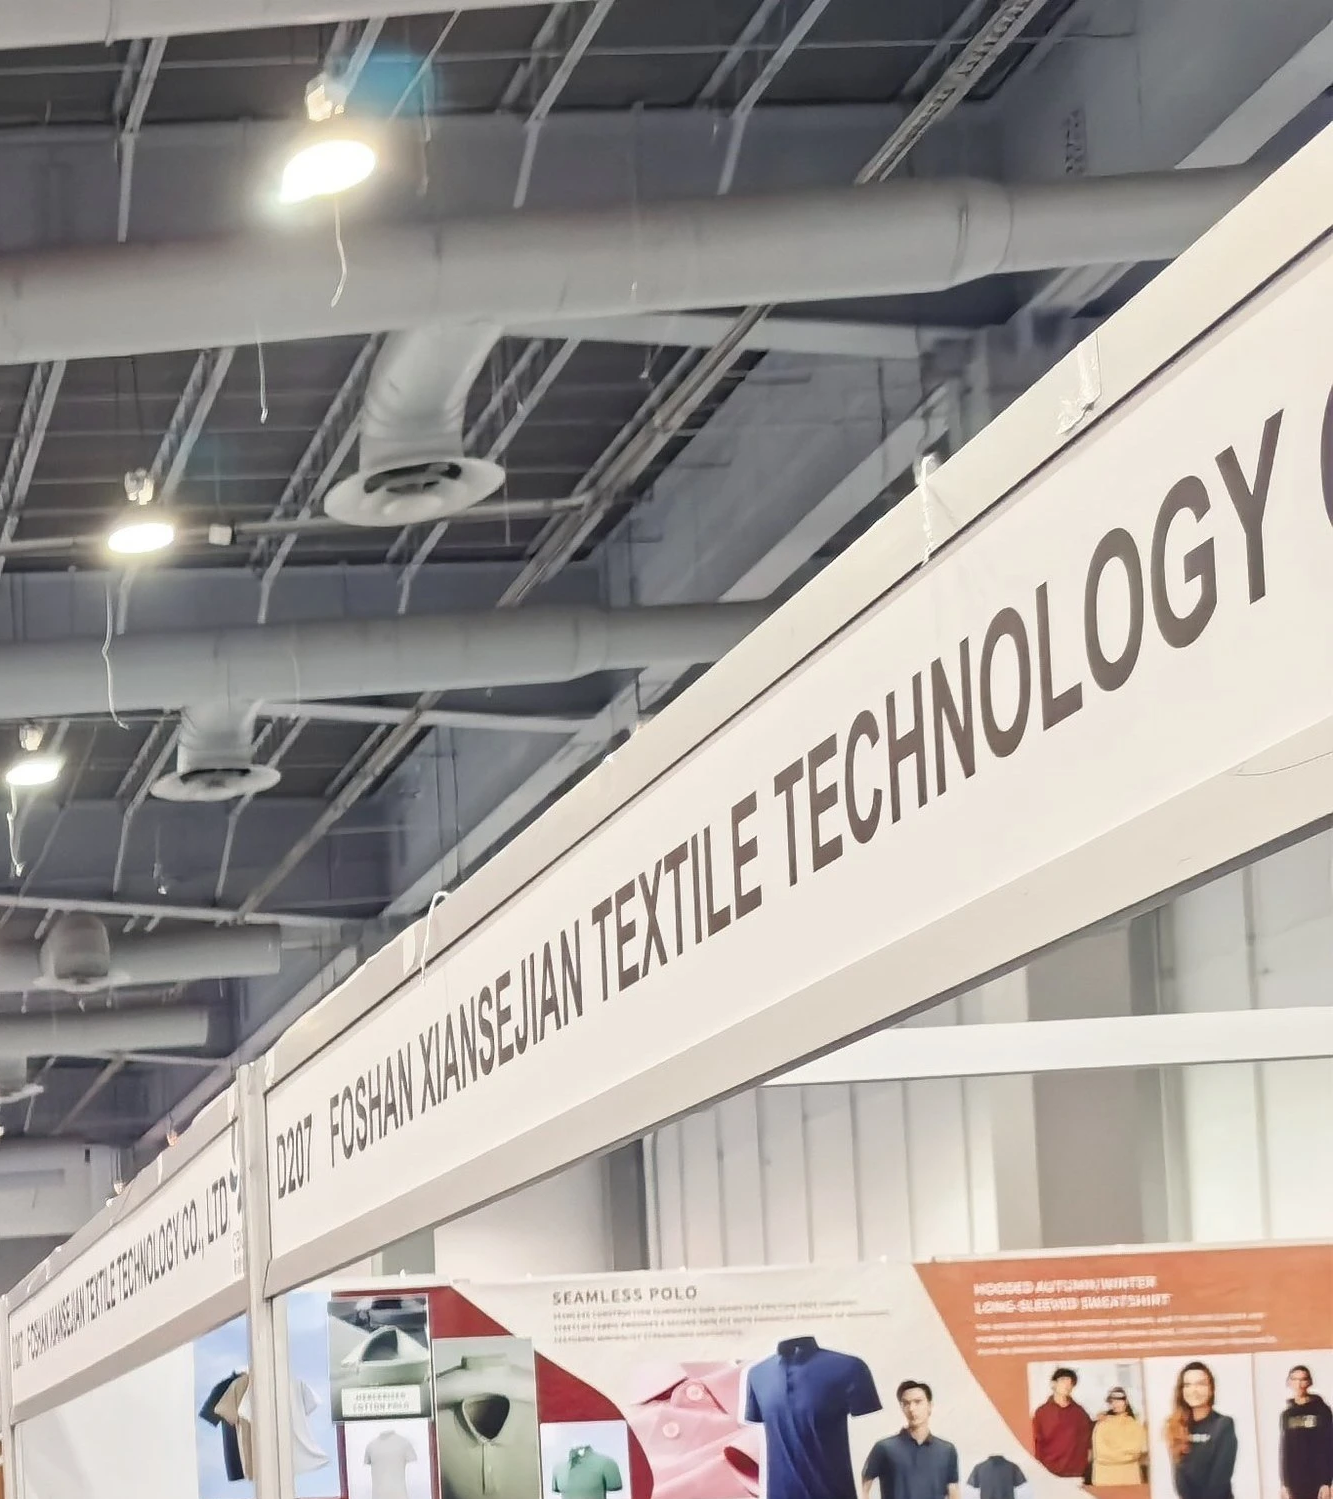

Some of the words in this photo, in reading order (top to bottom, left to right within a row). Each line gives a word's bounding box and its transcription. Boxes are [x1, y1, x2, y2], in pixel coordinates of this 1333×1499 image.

[276, 1113, 313, 1201] D207
[329, 1043, 415, 1170] FOSHAN
[418, 918, 584, 1109] XIANSEJIAN
[592, 790, 762, 1004] TEXTILE
[771, 408, 1284, 888] TECHNOLOGY
[117, 1211, 180, 1301] TECHNOLOGY
[552, 1287, 643, 1305] SEAMLESS
[649, 1285, 698, 1301] POLO
